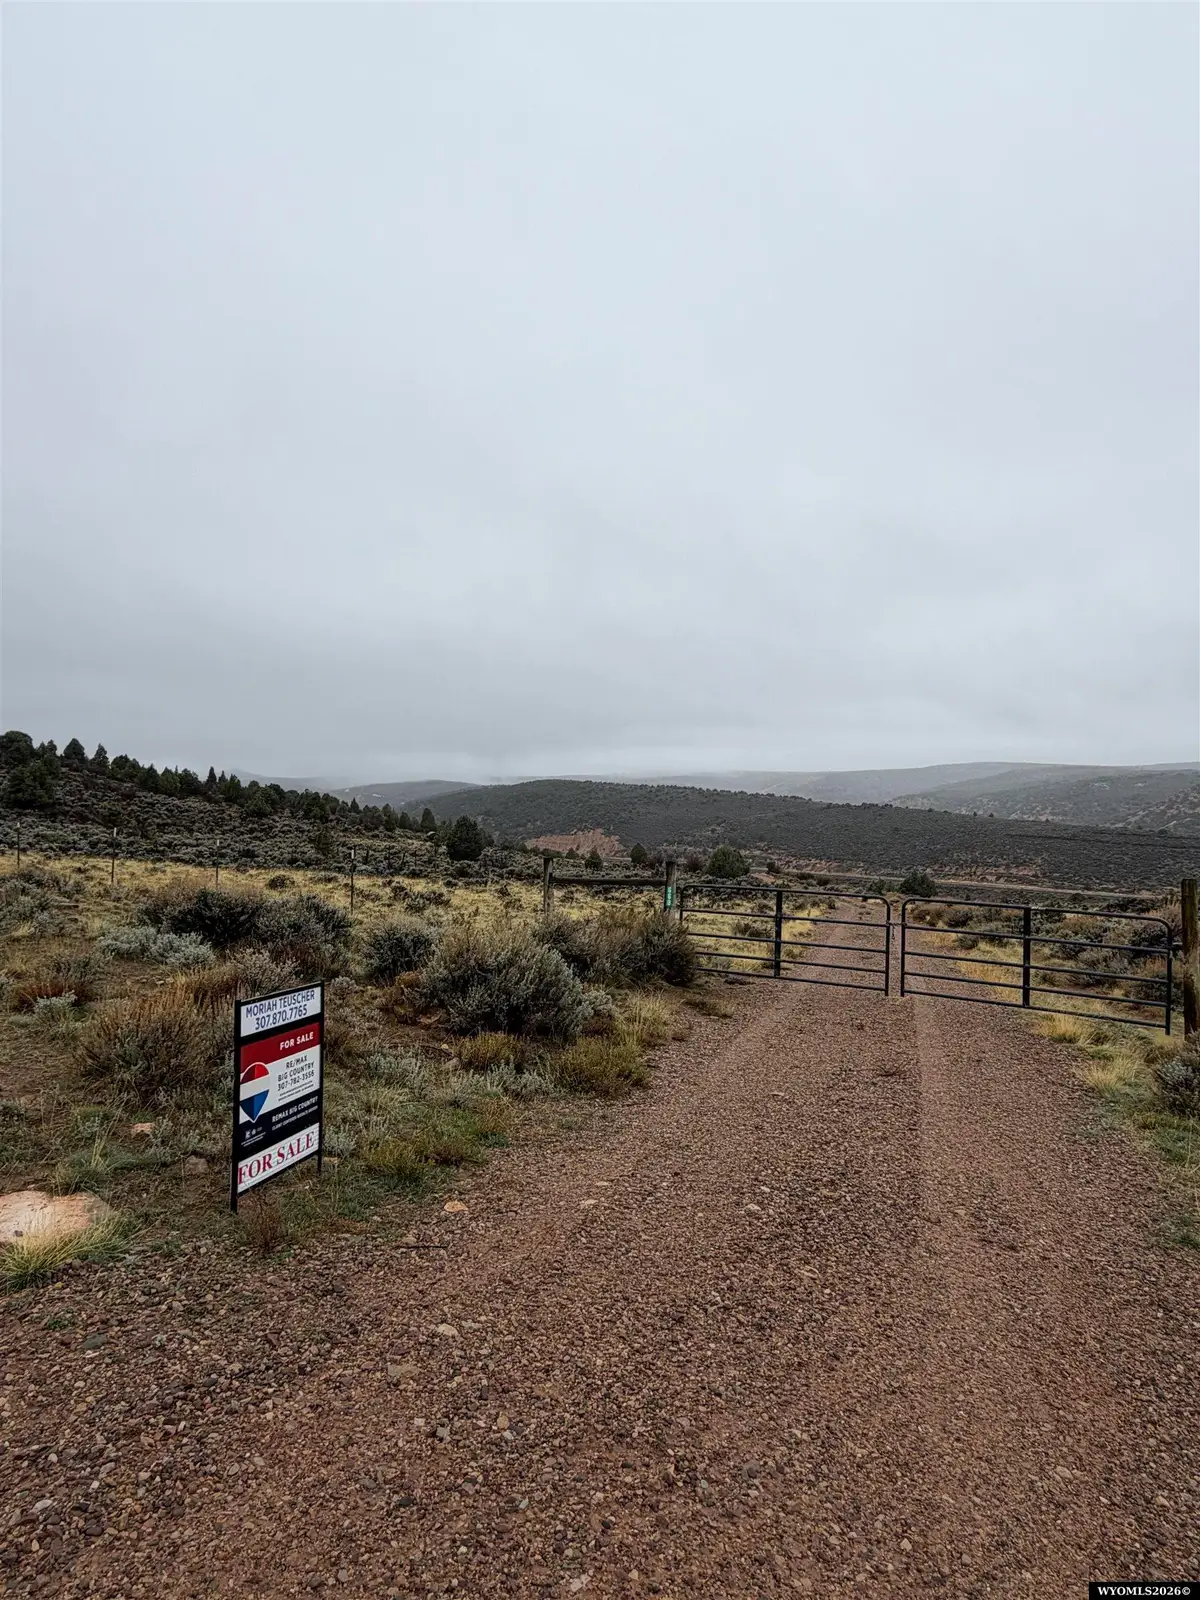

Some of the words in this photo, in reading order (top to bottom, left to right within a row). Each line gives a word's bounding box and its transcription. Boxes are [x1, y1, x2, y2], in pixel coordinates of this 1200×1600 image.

[246, 1000, 277, 1018] MORIAH
[279, 989, 315, 1009] TEUSCHER
[255, 1004, 307, 1030] 307.870.7765
[280, 1039, 295, 1050] FOR
[297, 1032, 313, 1044] SALE
[278, 1072, 288, 1082] BIG
[289, 1061, 314, 1077] COUNTRY
[286, 1055, 307, 1069] RE/MAX
[238, 1153, 273, 1185] FOR
[276, 1131, 314, 1165] SALE
